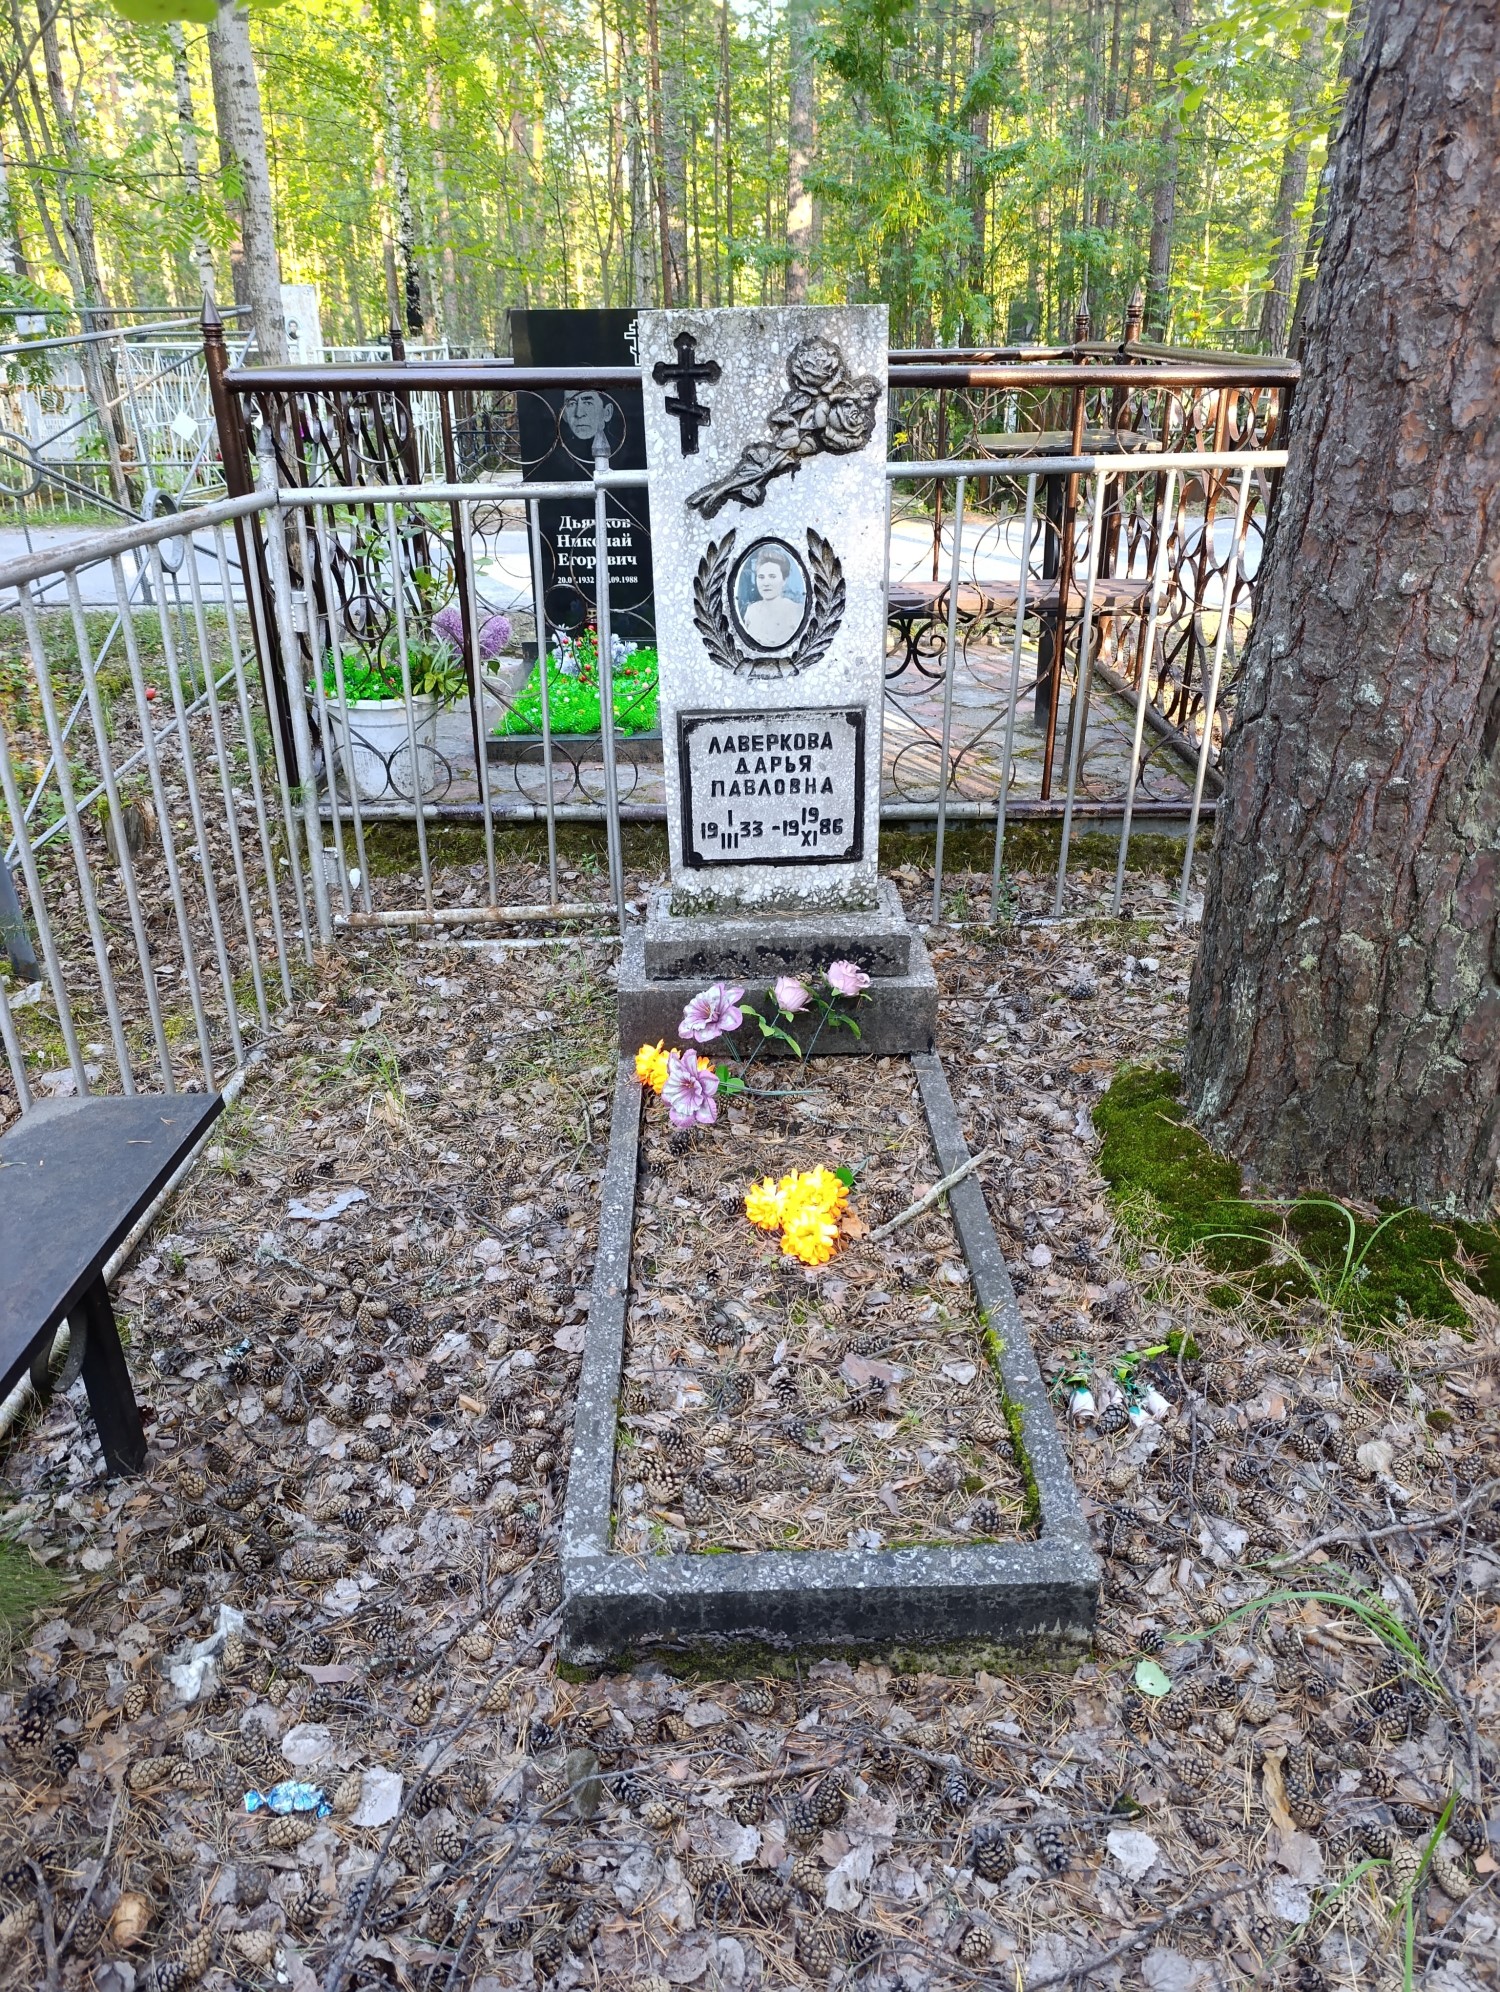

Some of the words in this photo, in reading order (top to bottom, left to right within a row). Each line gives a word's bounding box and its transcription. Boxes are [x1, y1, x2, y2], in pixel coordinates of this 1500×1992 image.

[559, 515, 632, 531] Дьяков
[557, 552, 638, 569] Егорвич
[557, 576, 595, 584] 20.0.1932
[708, 731, 833, 754] ЛАВЕРКОВА
[735, 755, 812, 774] ДАРЬЯ
[711, 777, 834, 798] ПАВЛОВНА
